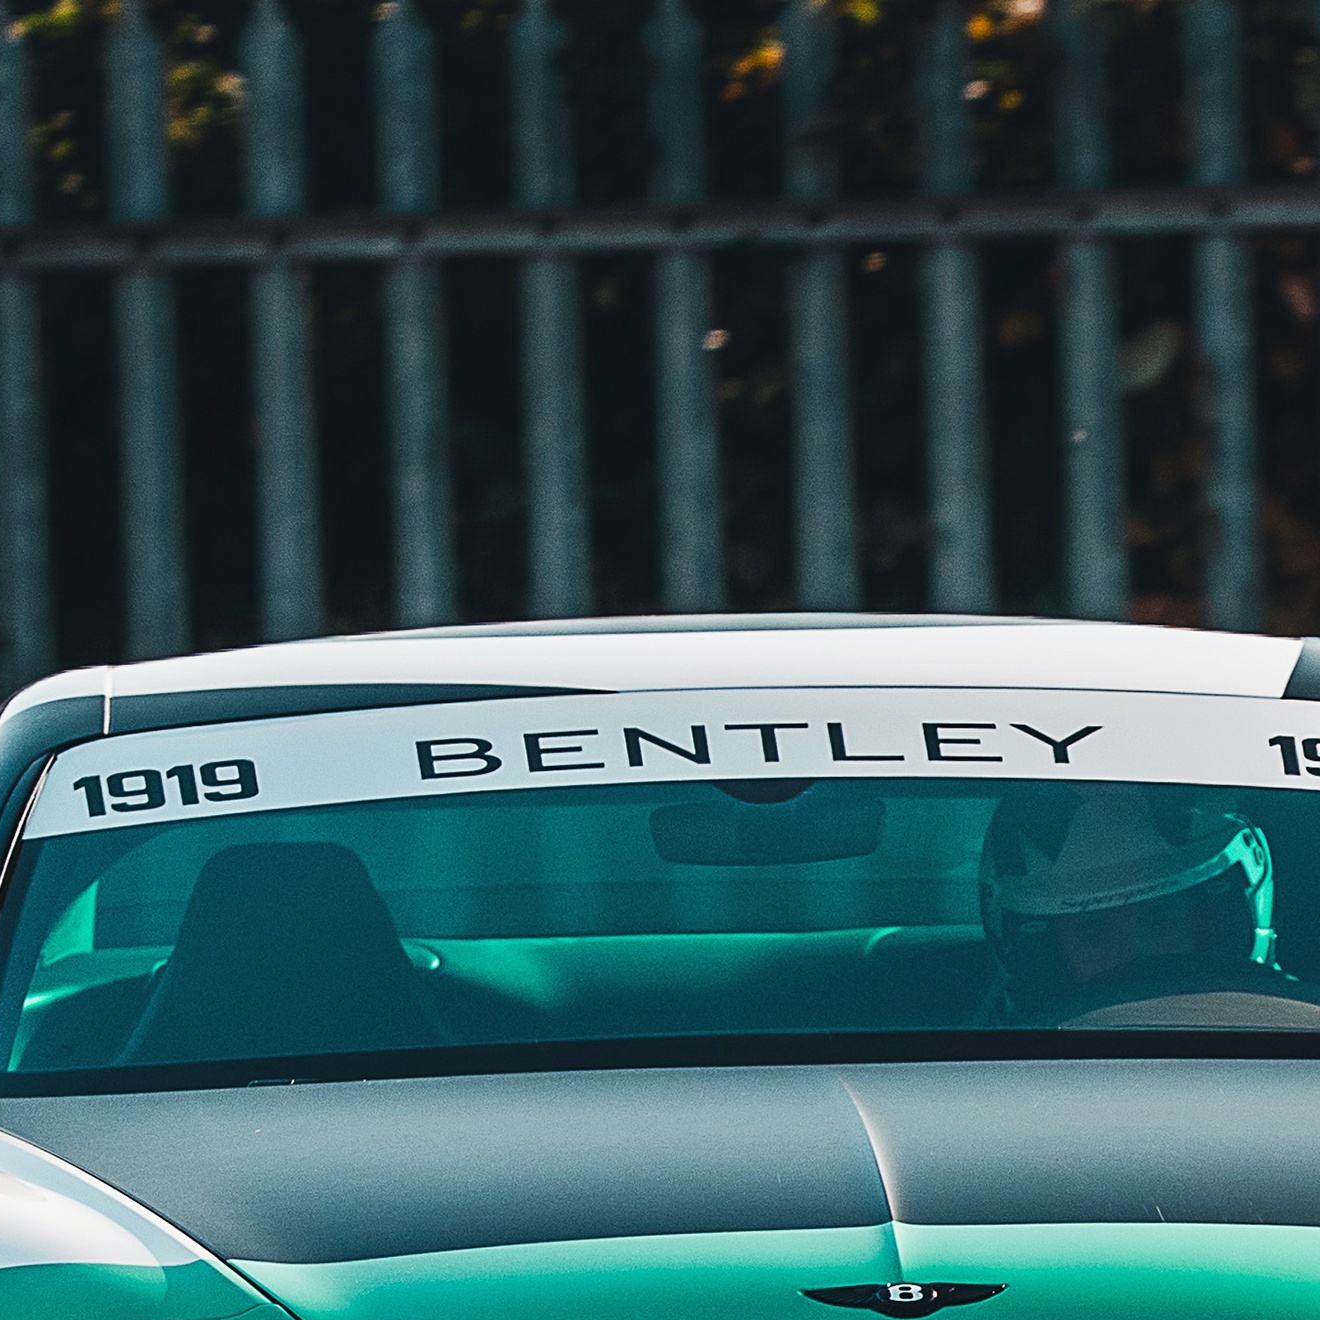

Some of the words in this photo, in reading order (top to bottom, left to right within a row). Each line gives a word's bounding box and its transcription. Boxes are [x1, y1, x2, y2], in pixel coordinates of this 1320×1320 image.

[415, 722, 1103, 780] BENTLEY
[73, 759, 259, 818] 1919
[888, 1283, 923, 1302] B
